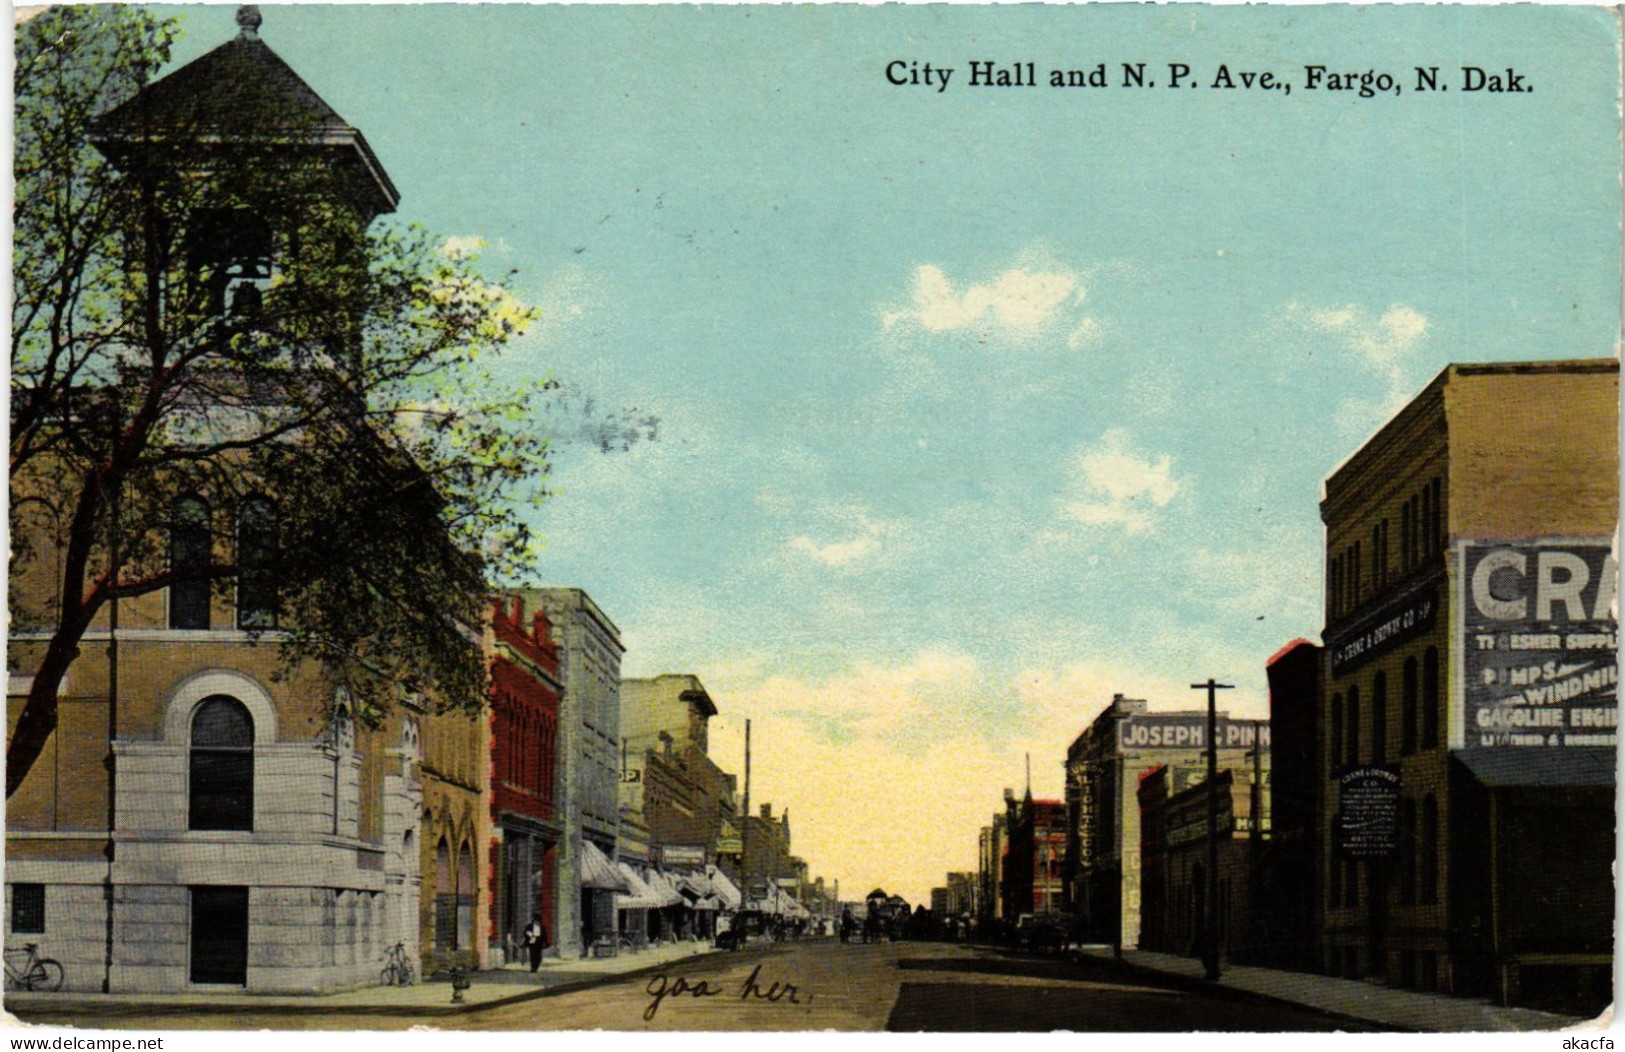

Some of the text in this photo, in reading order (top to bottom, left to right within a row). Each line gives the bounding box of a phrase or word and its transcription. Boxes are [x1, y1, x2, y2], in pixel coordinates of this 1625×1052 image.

[1475, 634, 1561, 649] THESHER
[1482, 661, 1556, 685] PMPS
[1124, 725, 1203, 746] JOSEPH
